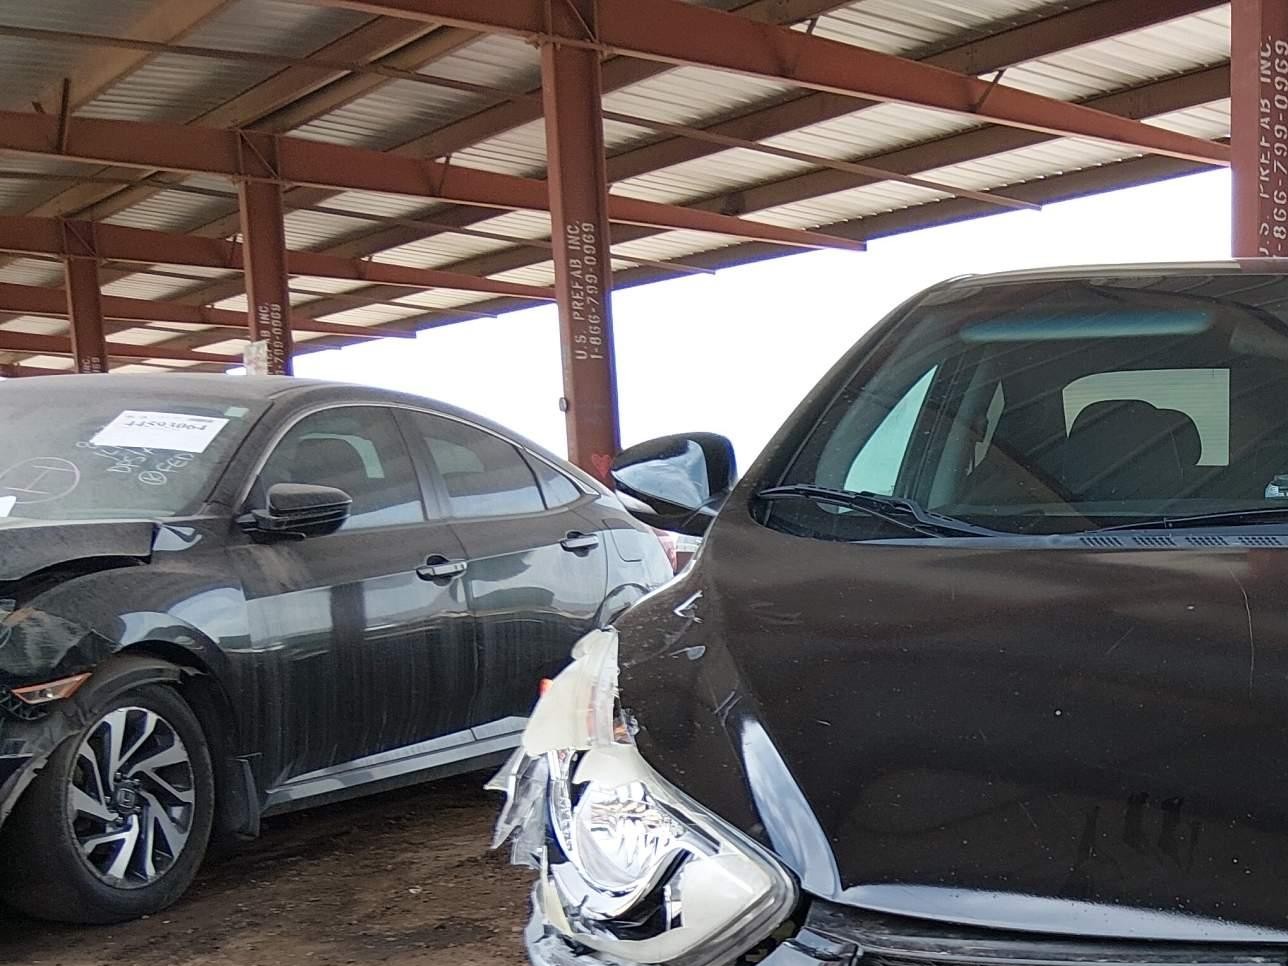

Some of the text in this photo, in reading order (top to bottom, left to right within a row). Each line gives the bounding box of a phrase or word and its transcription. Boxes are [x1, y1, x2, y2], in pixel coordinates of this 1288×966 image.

[1260, 35, 1272, 83] INC.
[1259, 98, 1271, 199] PREFAB
[1273, 40, 1288, 258] -866-799-0969
[567, 220, 588, 360] U.S. PREFAB INC.
[582, 222, 603, 359] 1-866-799-0969
